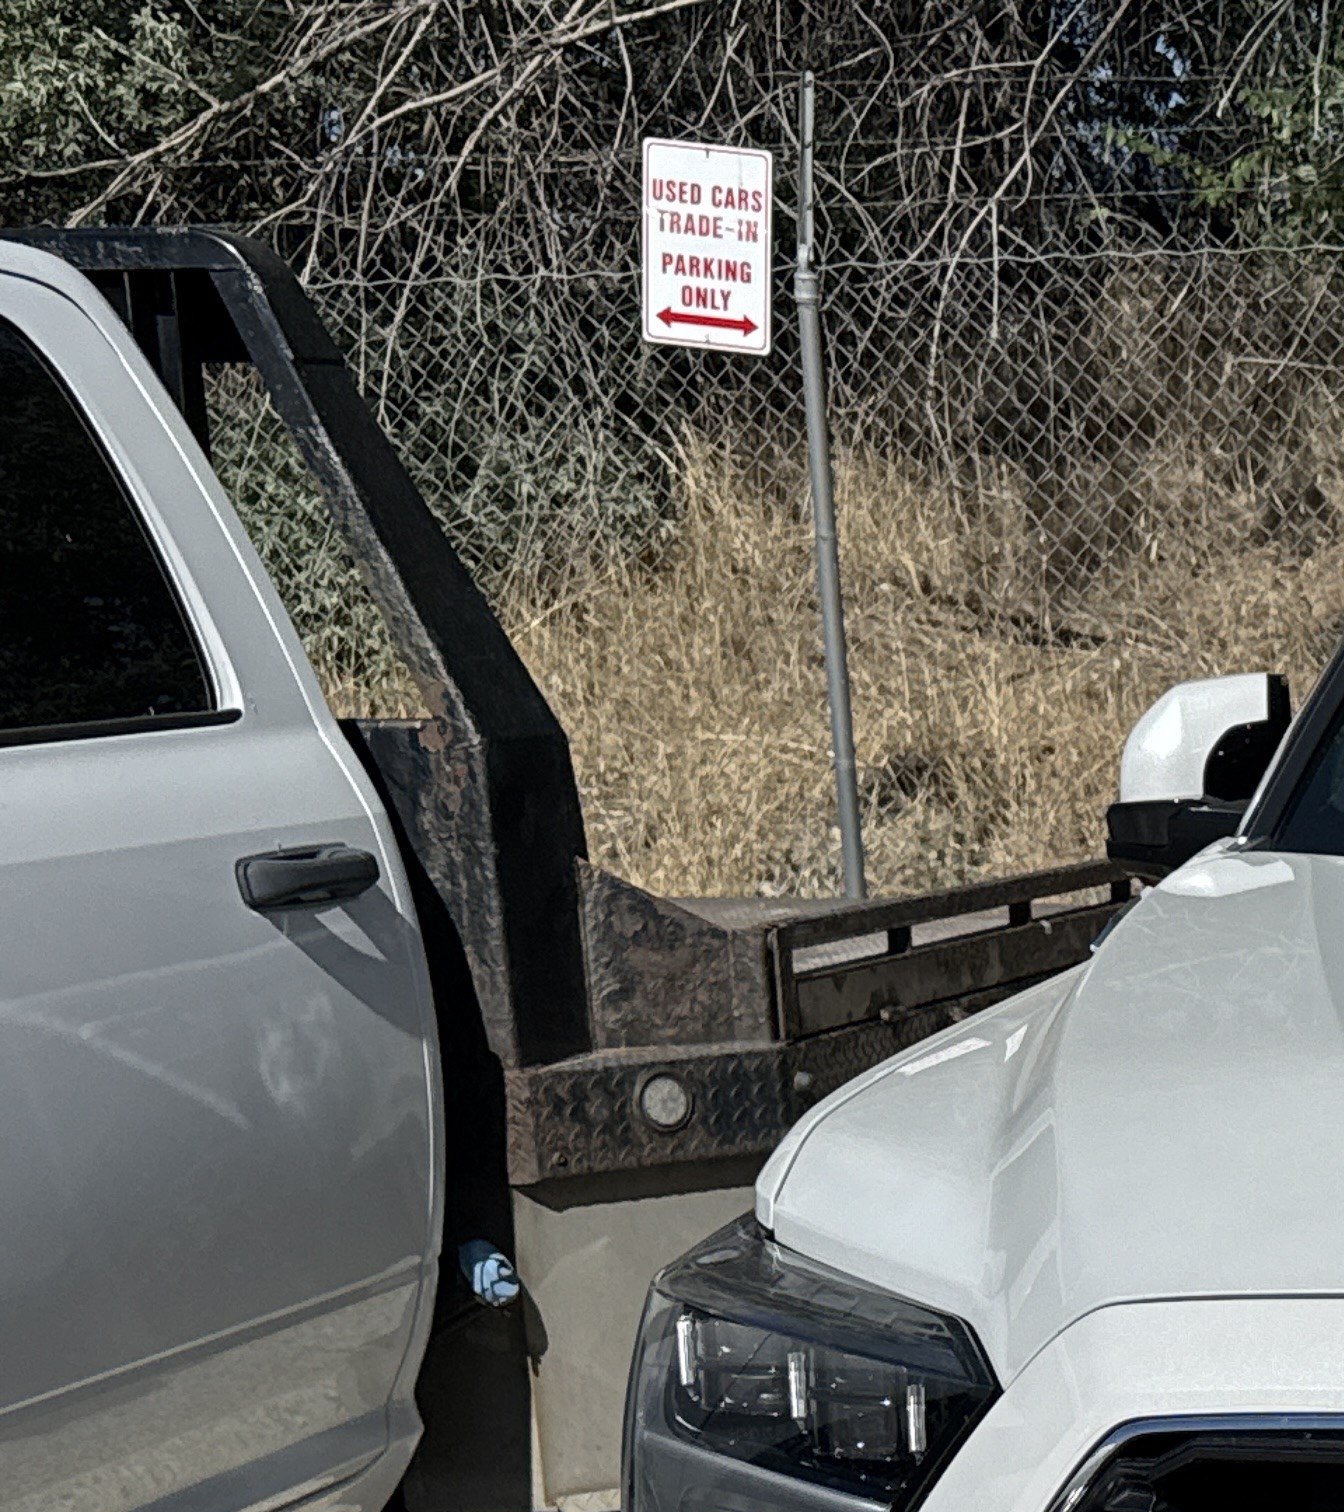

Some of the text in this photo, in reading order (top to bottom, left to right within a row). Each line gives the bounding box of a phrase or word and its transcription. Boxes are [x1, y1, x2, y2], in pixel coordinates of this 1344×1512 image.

[652, 178, 763, 213] USED CARS
[657, 208, 759, 243] TRADE-IN
[662, 252, 752, 284] PARKING
[681, 285, 732, 312] ONLY
